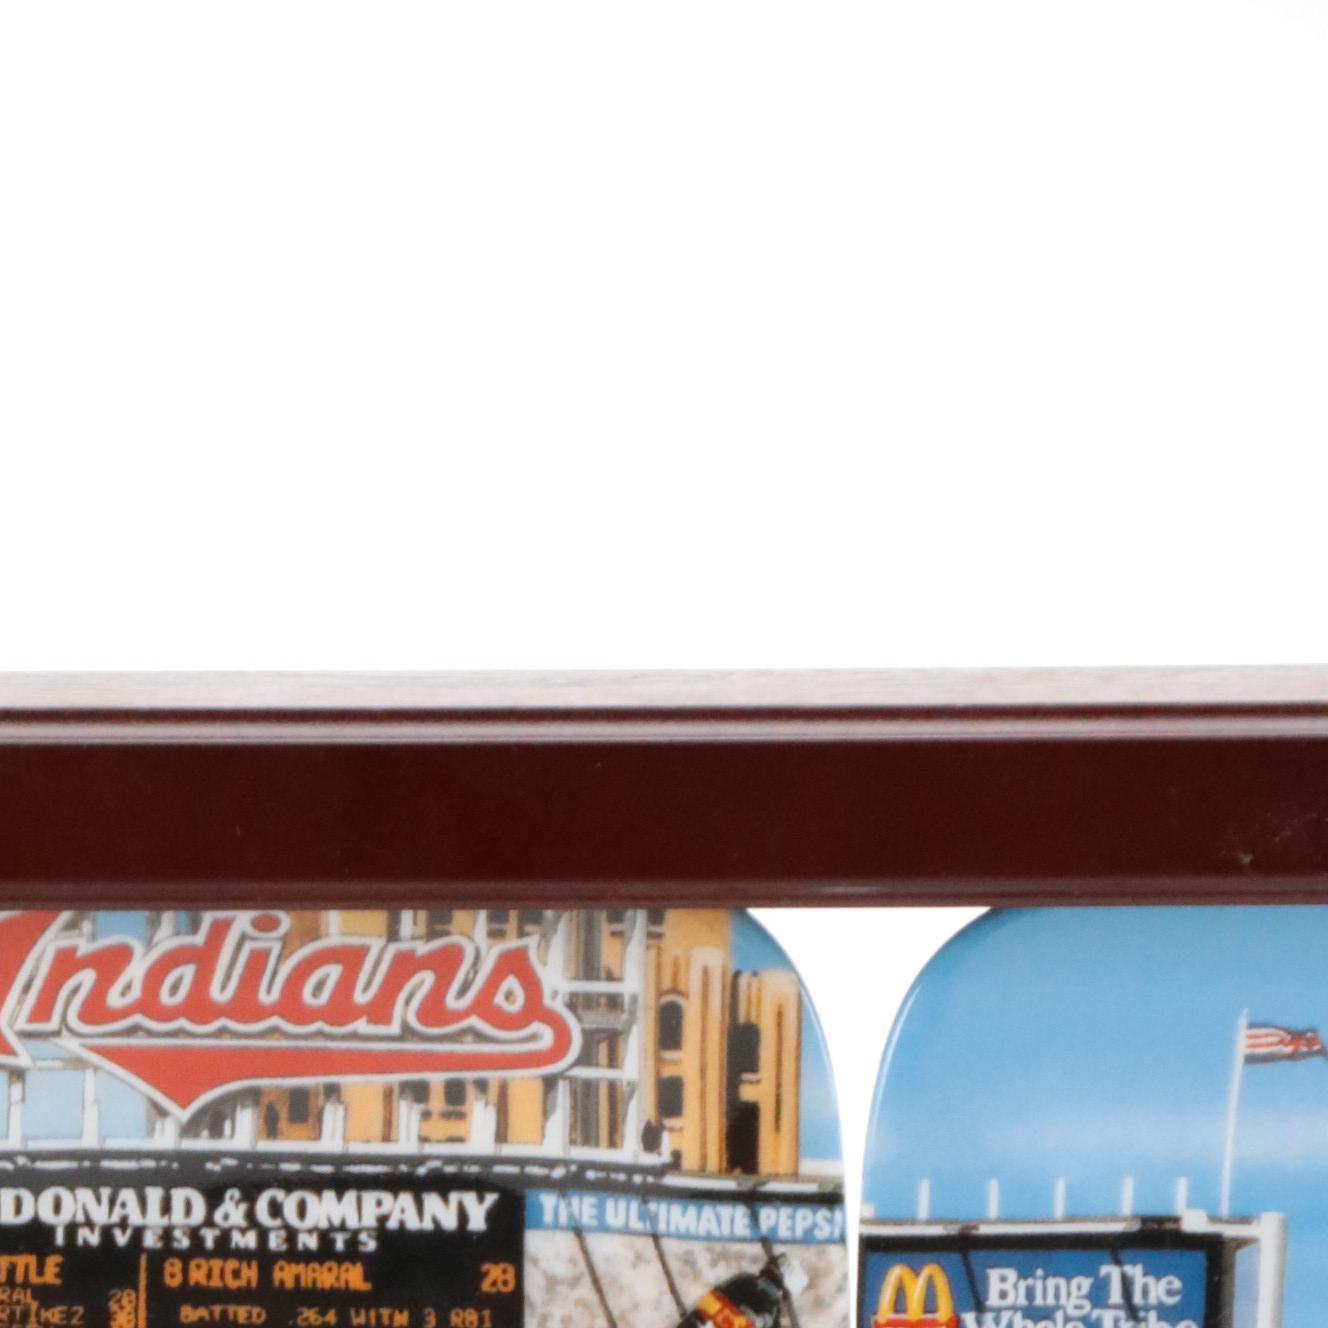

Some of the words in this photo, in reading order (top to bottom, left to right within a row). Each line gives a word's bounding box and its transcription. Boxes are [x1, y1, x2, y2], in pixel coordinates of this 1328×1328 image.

[213, 1188, 250, 1229] &
[255, 1188, 500, 1233] COMPANY
[538, 1193, 599, 1227] THE
[55, 1225, 379, 1252] INVESTMENTS
[163, 1257, 183, 1288] 8
[187, 1258, 259, 1290] RICH
[272, 1259, 372, 1292] AMARAL
[985, 1266, 1094, 1318] Bring
[1099, 1263, 1184, 1307] The
[178, 1304, 267, 1326] BATTED
[350, 1308, 410, 1328] WITH
